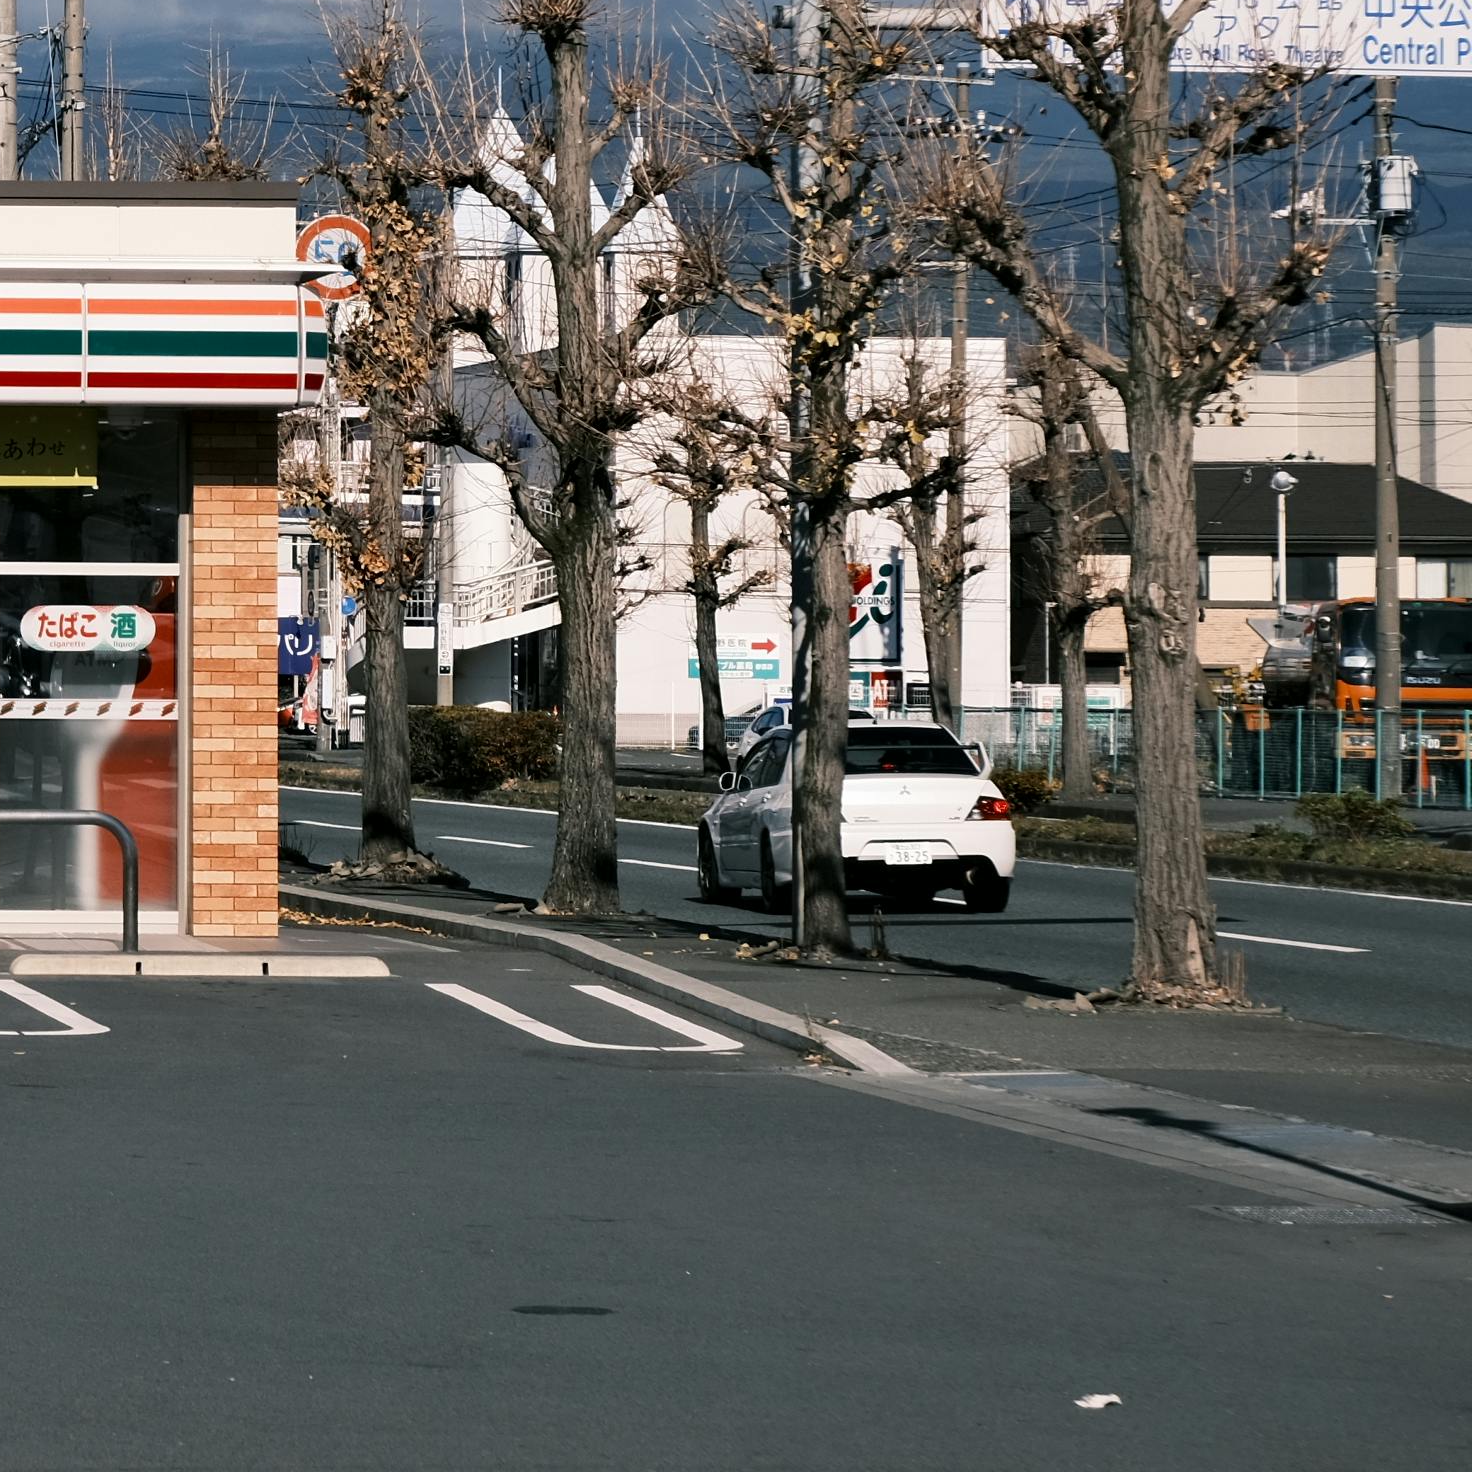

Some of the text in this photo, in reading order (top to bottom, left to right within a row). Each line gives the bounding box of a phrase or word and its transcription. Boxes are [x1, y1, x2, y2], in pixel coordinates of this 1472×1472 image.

[1363, 35, 1444, 65] Central
[38, 611, 136, 638] たばこ 酒
[113, 640, 136, 648] liquor
[278, 634, 313, 655] パリ
[1406, 676, 1441, 684] ISUZU
[896, 851, 929, 862] 38-25
